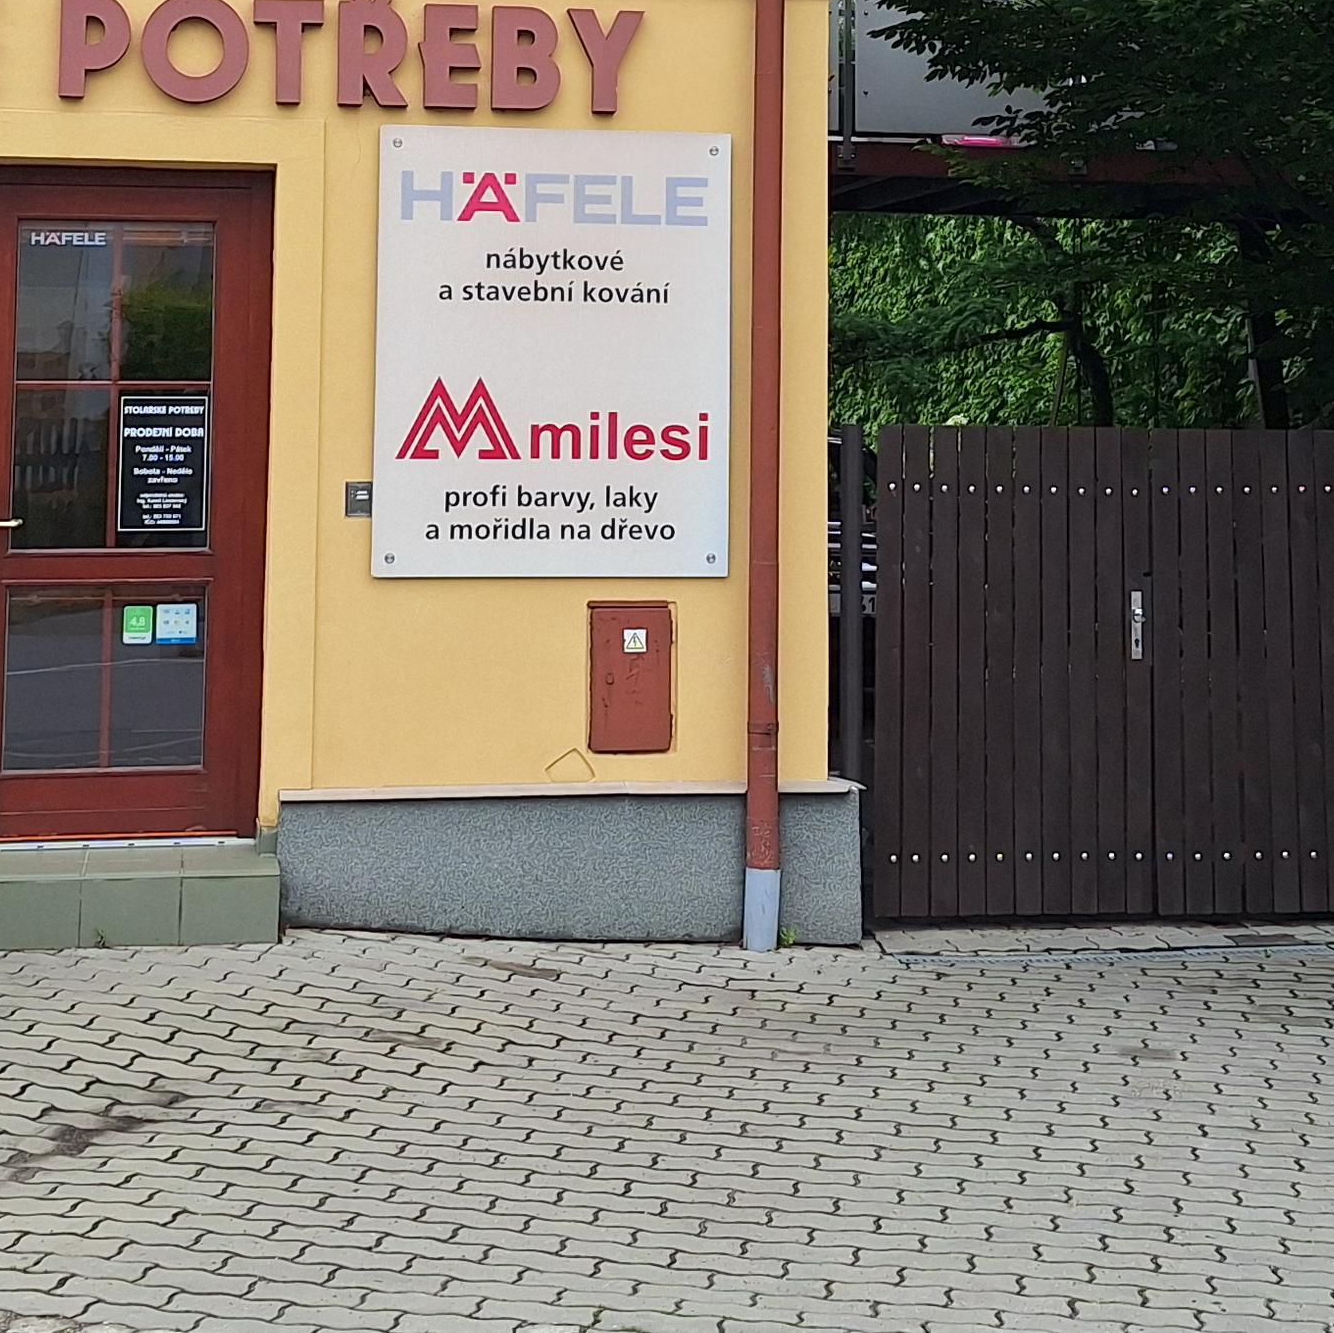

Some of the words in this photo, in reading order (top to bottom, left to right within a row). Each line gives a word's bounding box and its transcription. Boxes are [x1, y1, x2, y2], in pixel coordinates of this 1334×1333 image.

[401, 170, 708, 227] HÄFELE
[30, 232, 107, 246] HÄFELE
[486, 248, 624, 275] nábytkové
[439, 284, 452, 300] a
[462, 280, 574, 302] stavební
[583, 281, 670, 304] kování
[175, 427, 204, 437] DOBA
[530, 411, 709, 461] milesi
[445, 485, 507, 513] profi
[517, 485, 595, 513] barvy,
[605, 485, 658, 513] laky
[425, 524, 439, 540] a
[449, 518, 550, 540] mořidla
[560, 524, 591, 540] na
[600, 518, 676, 541] dřevo
